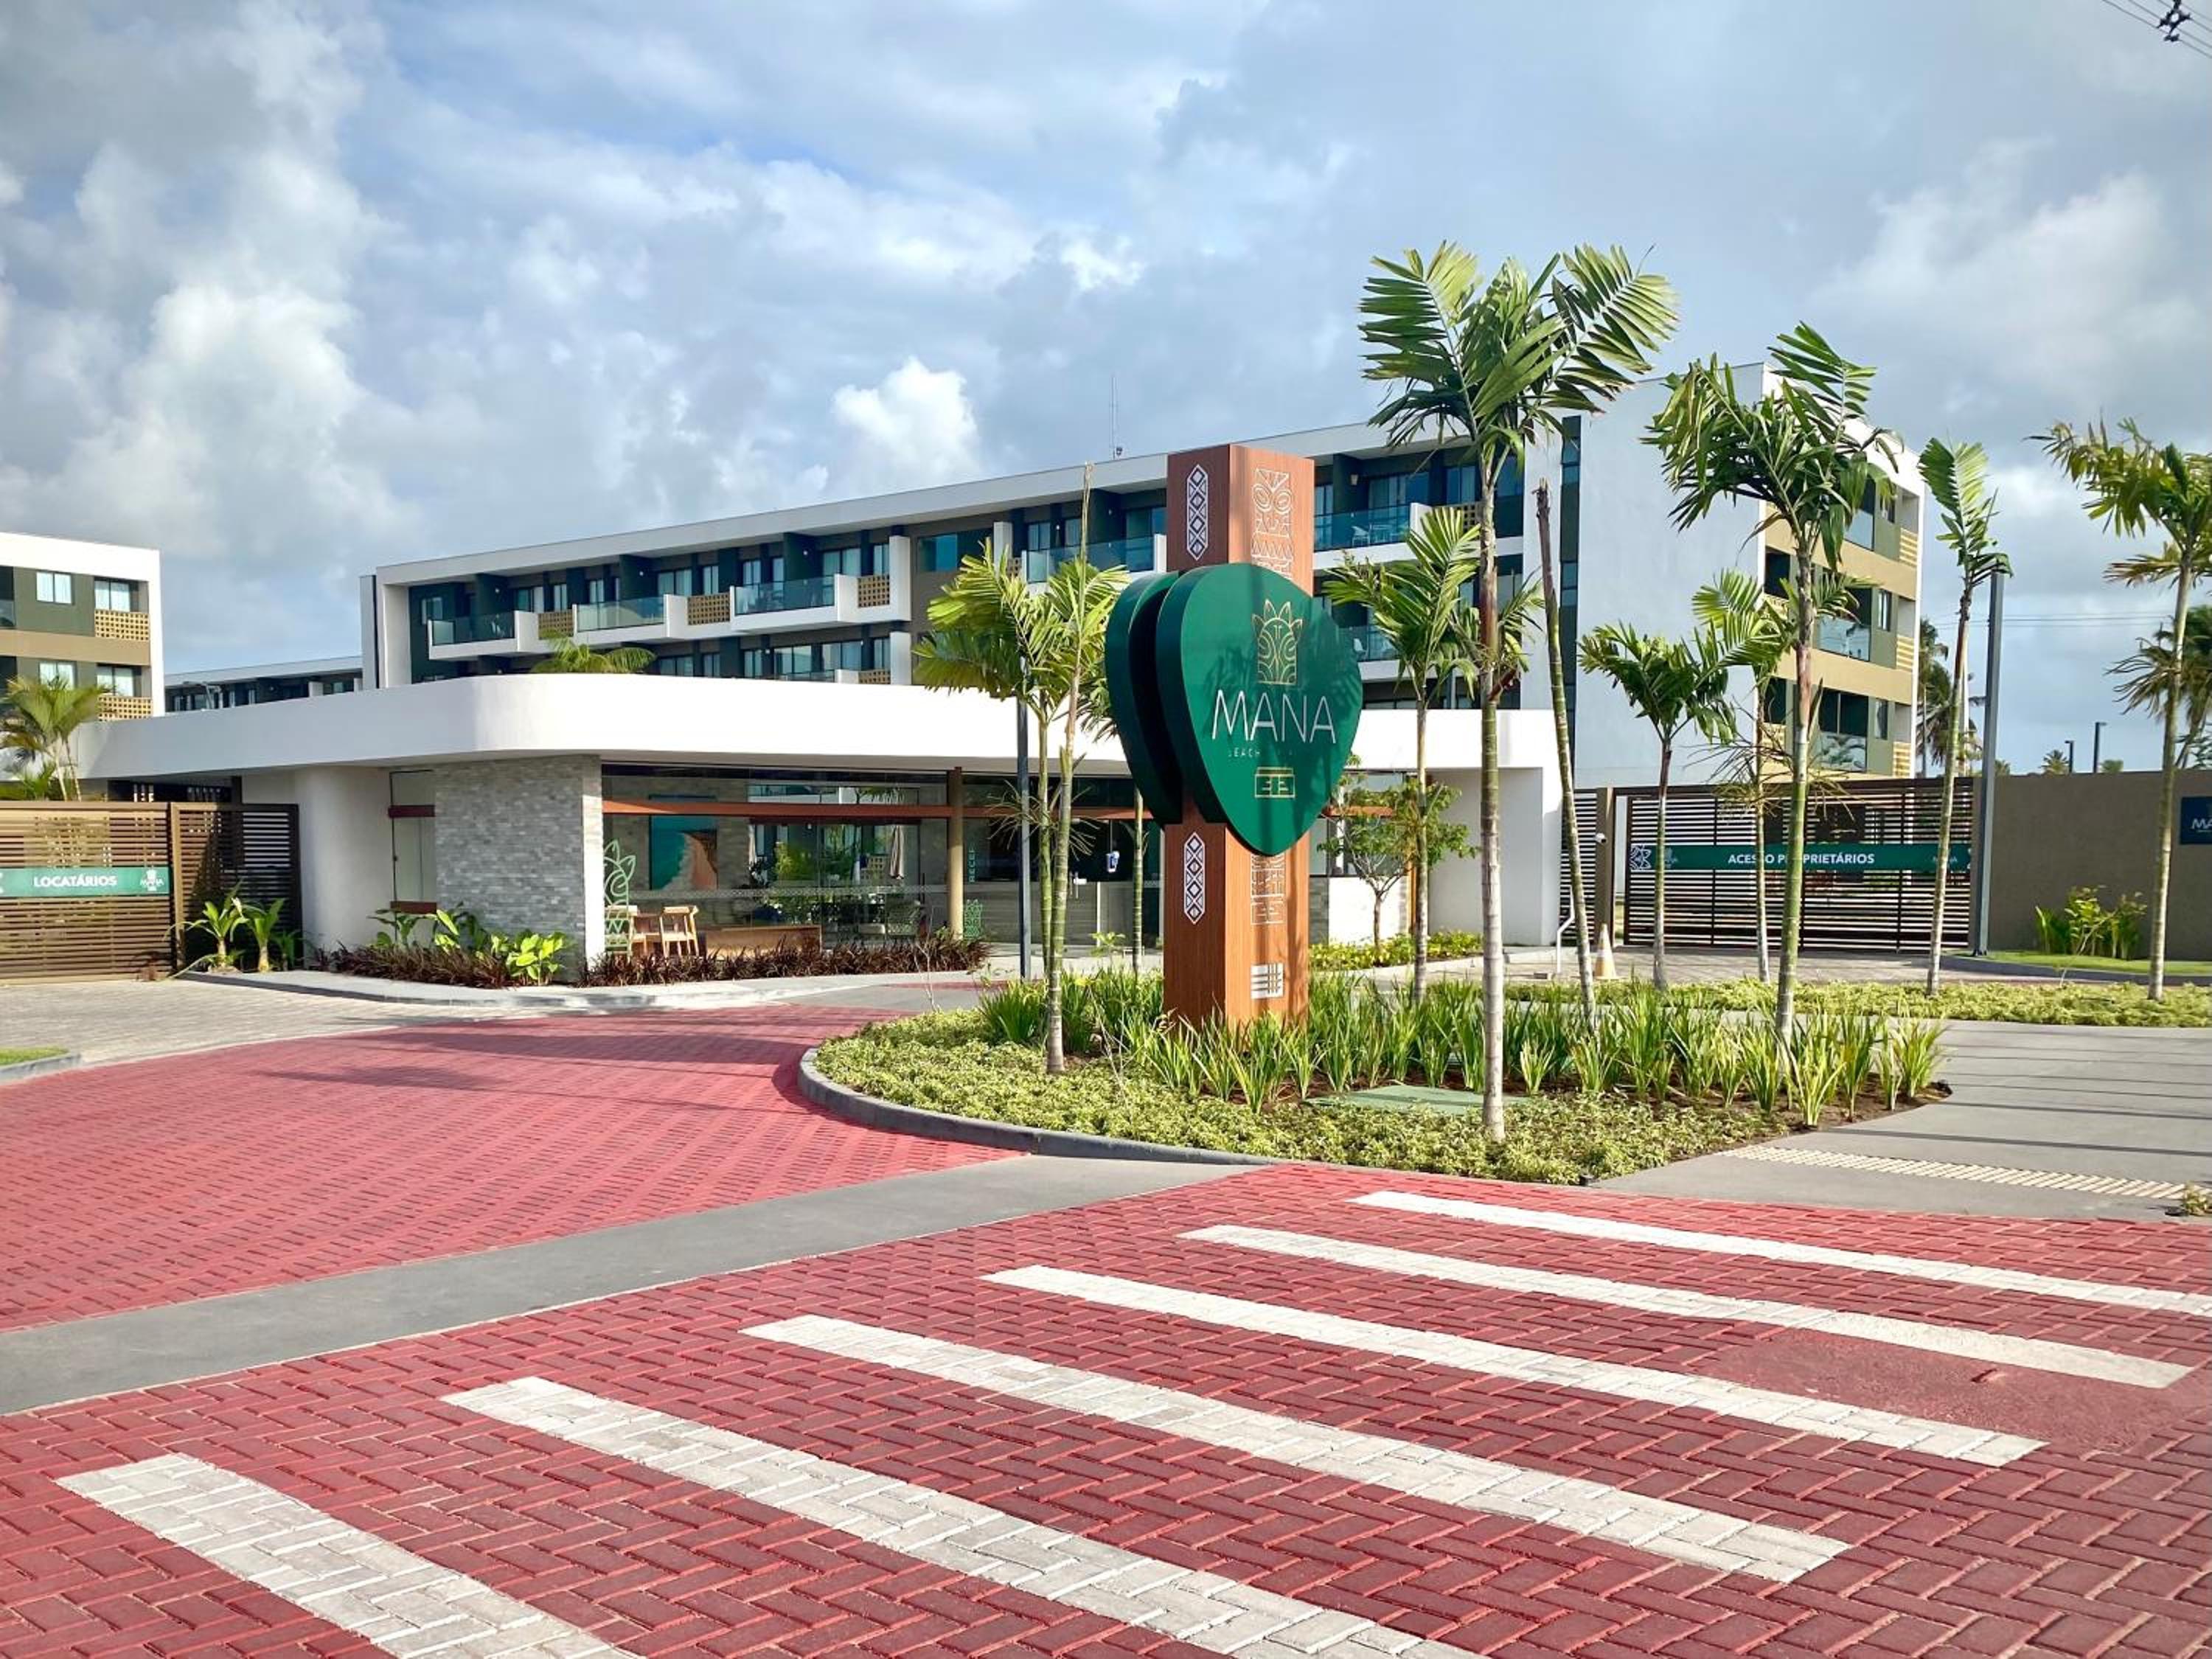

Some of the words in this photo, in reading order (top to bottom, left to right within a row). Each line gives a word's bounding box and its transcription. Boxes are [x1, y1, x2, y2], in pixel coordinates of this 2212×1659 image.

[1211, 689, 1337, 744] MANA
[1728, 854, 1775, 864] ACESO
[1778, 852, 1875, 865] PPRIETÁRIOS
[34, 873, 118, 888] LOCATÁRIOS
